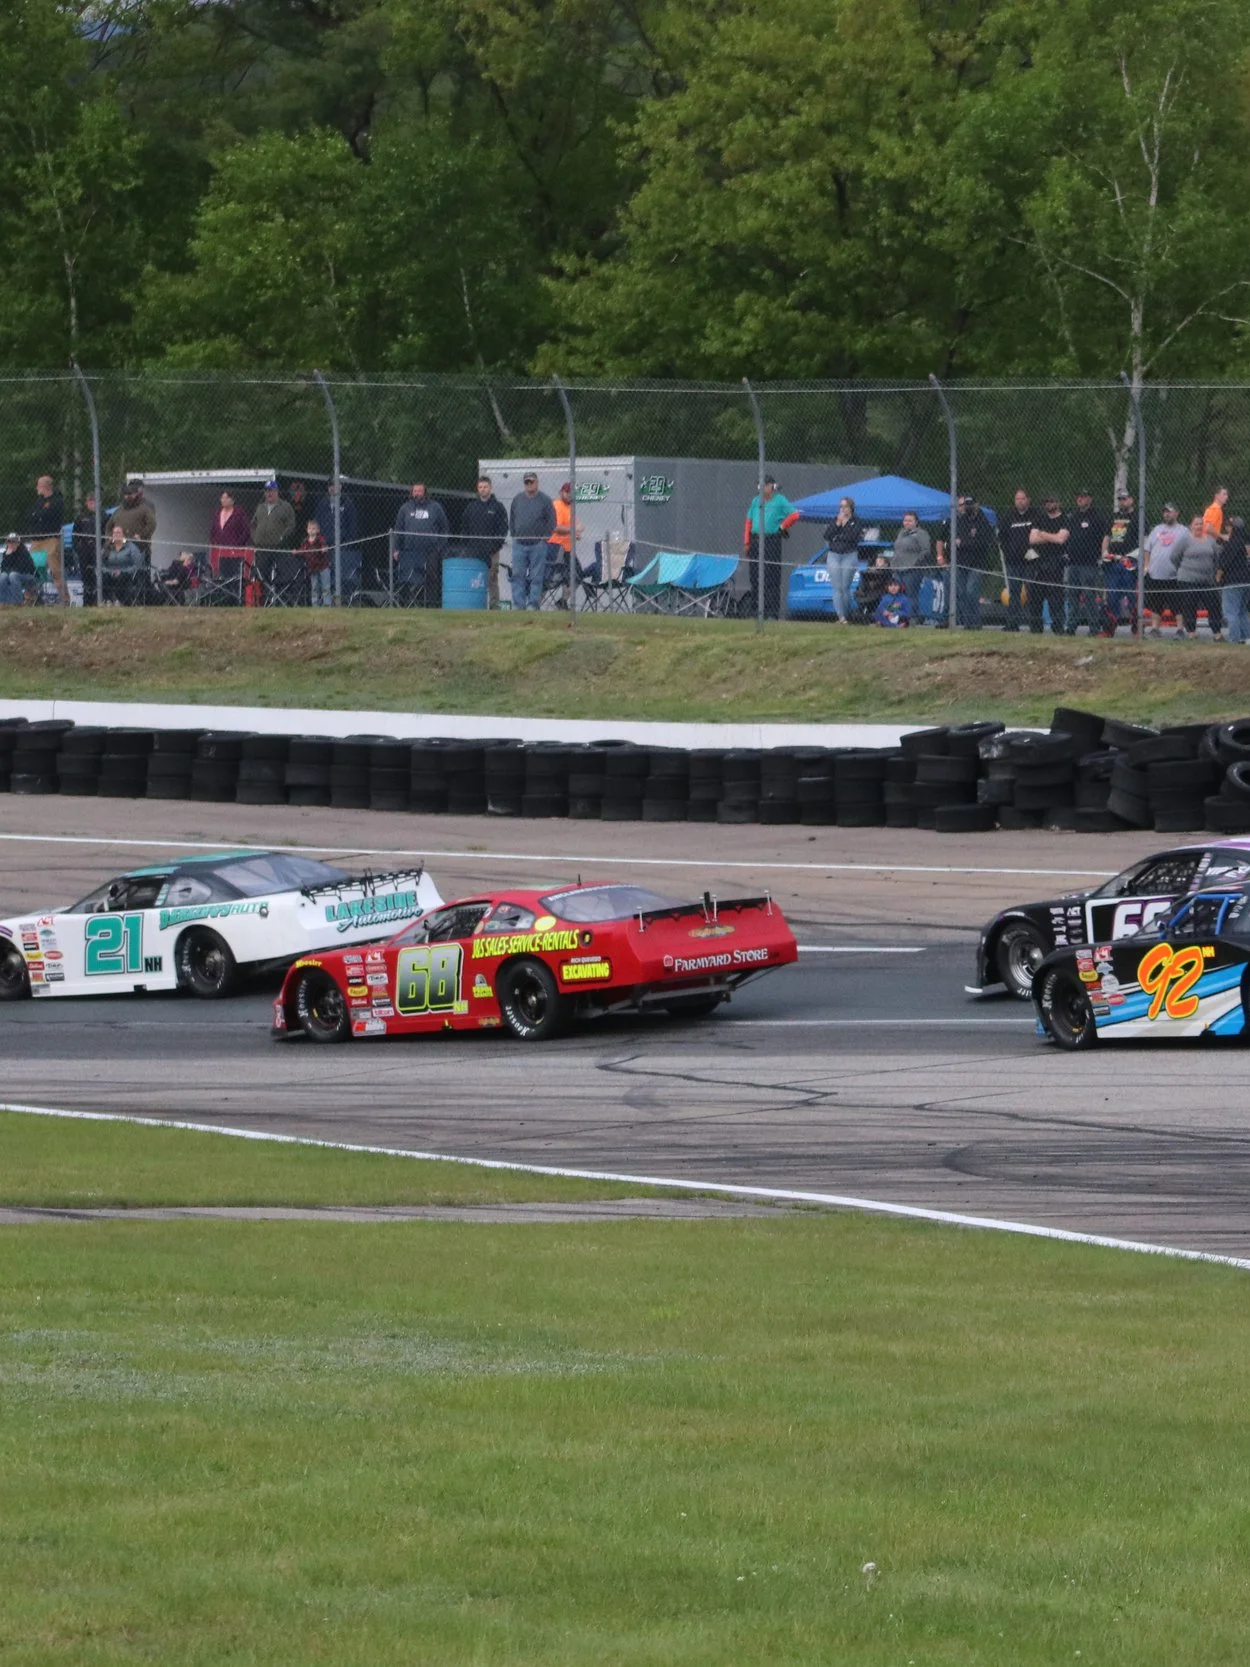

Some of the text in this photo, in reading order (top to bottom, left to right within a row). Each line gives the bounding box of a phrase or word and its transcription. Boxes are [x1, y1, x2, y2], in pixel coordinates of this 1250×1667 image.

[581, 482, 600, 495] 29
[649, 476, 666, 495] 29
[325, 891, 418, 922] LAKESIDE
[337, 908, 424, 932] Automotive
[85, 913, 144, 976] 21
[145, 957, 162, 973] NH
[562, 962, 610, 980] EXCAVATING
[674, 948, 768, 972] FARMYARD STORE
[397, 946, 464, 1016] 68
[1137, 943, 1204, 1020] 92
